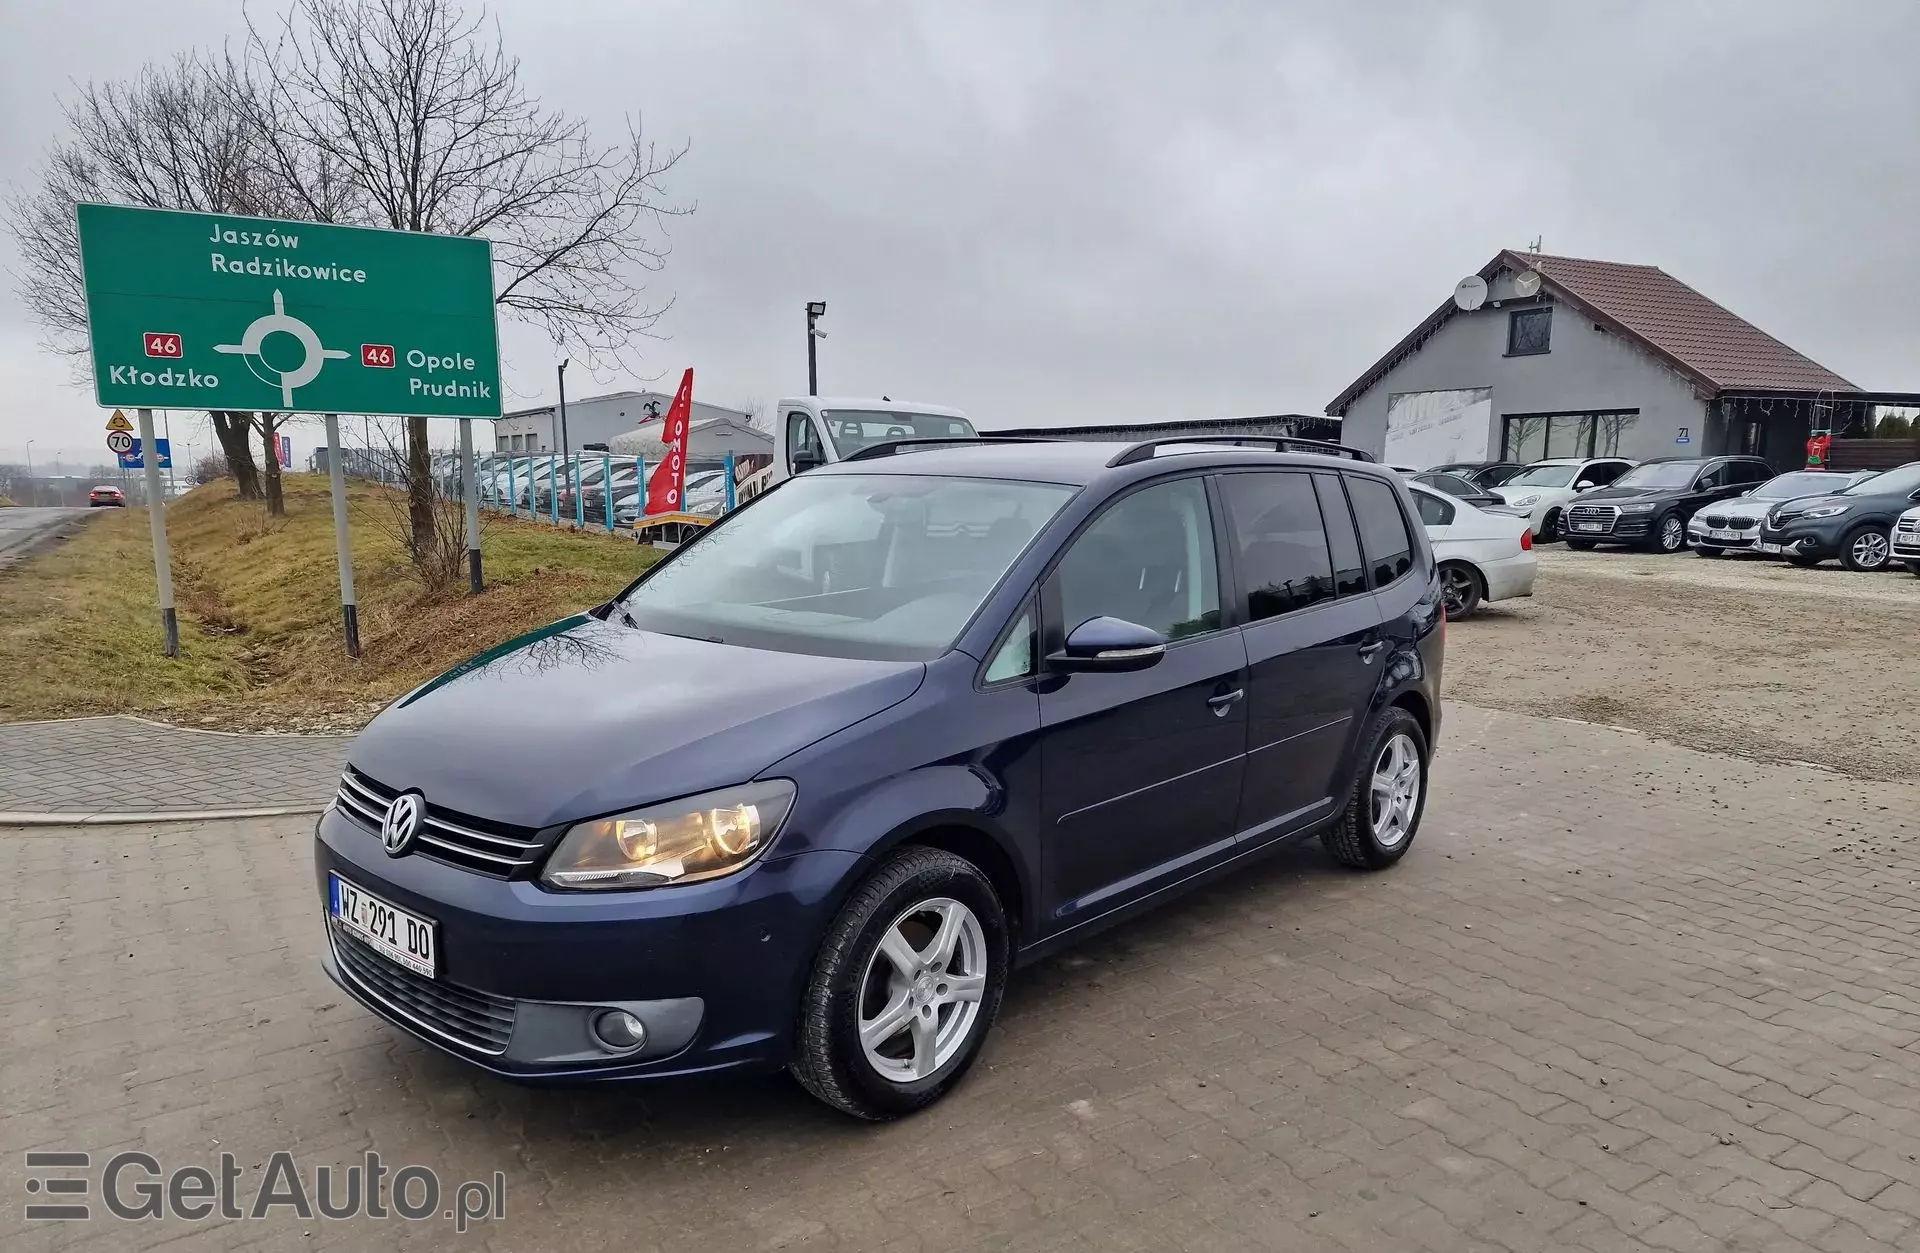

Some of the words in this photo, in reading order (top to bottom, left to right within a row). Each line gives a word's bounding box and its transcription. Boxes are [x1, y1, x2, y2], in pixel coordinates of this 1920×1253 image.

[209, 223, 299, 249] Jaszów
[210, 252, 367, 284] Radzikowice
[149, 336, 177, 355] 46
[366, 348, 390, 365] 46
[406, 349, 476, 372] Opole
[109, 364, 219, 389] Kłodzko
[409, 378, 491, 399] Prudnik
[112, 436, 131, 448] 70
[1678, 427, 1689, 438] 71
[341, 884, 359, 925] WZ
[369, 900, 397, 946] 291
